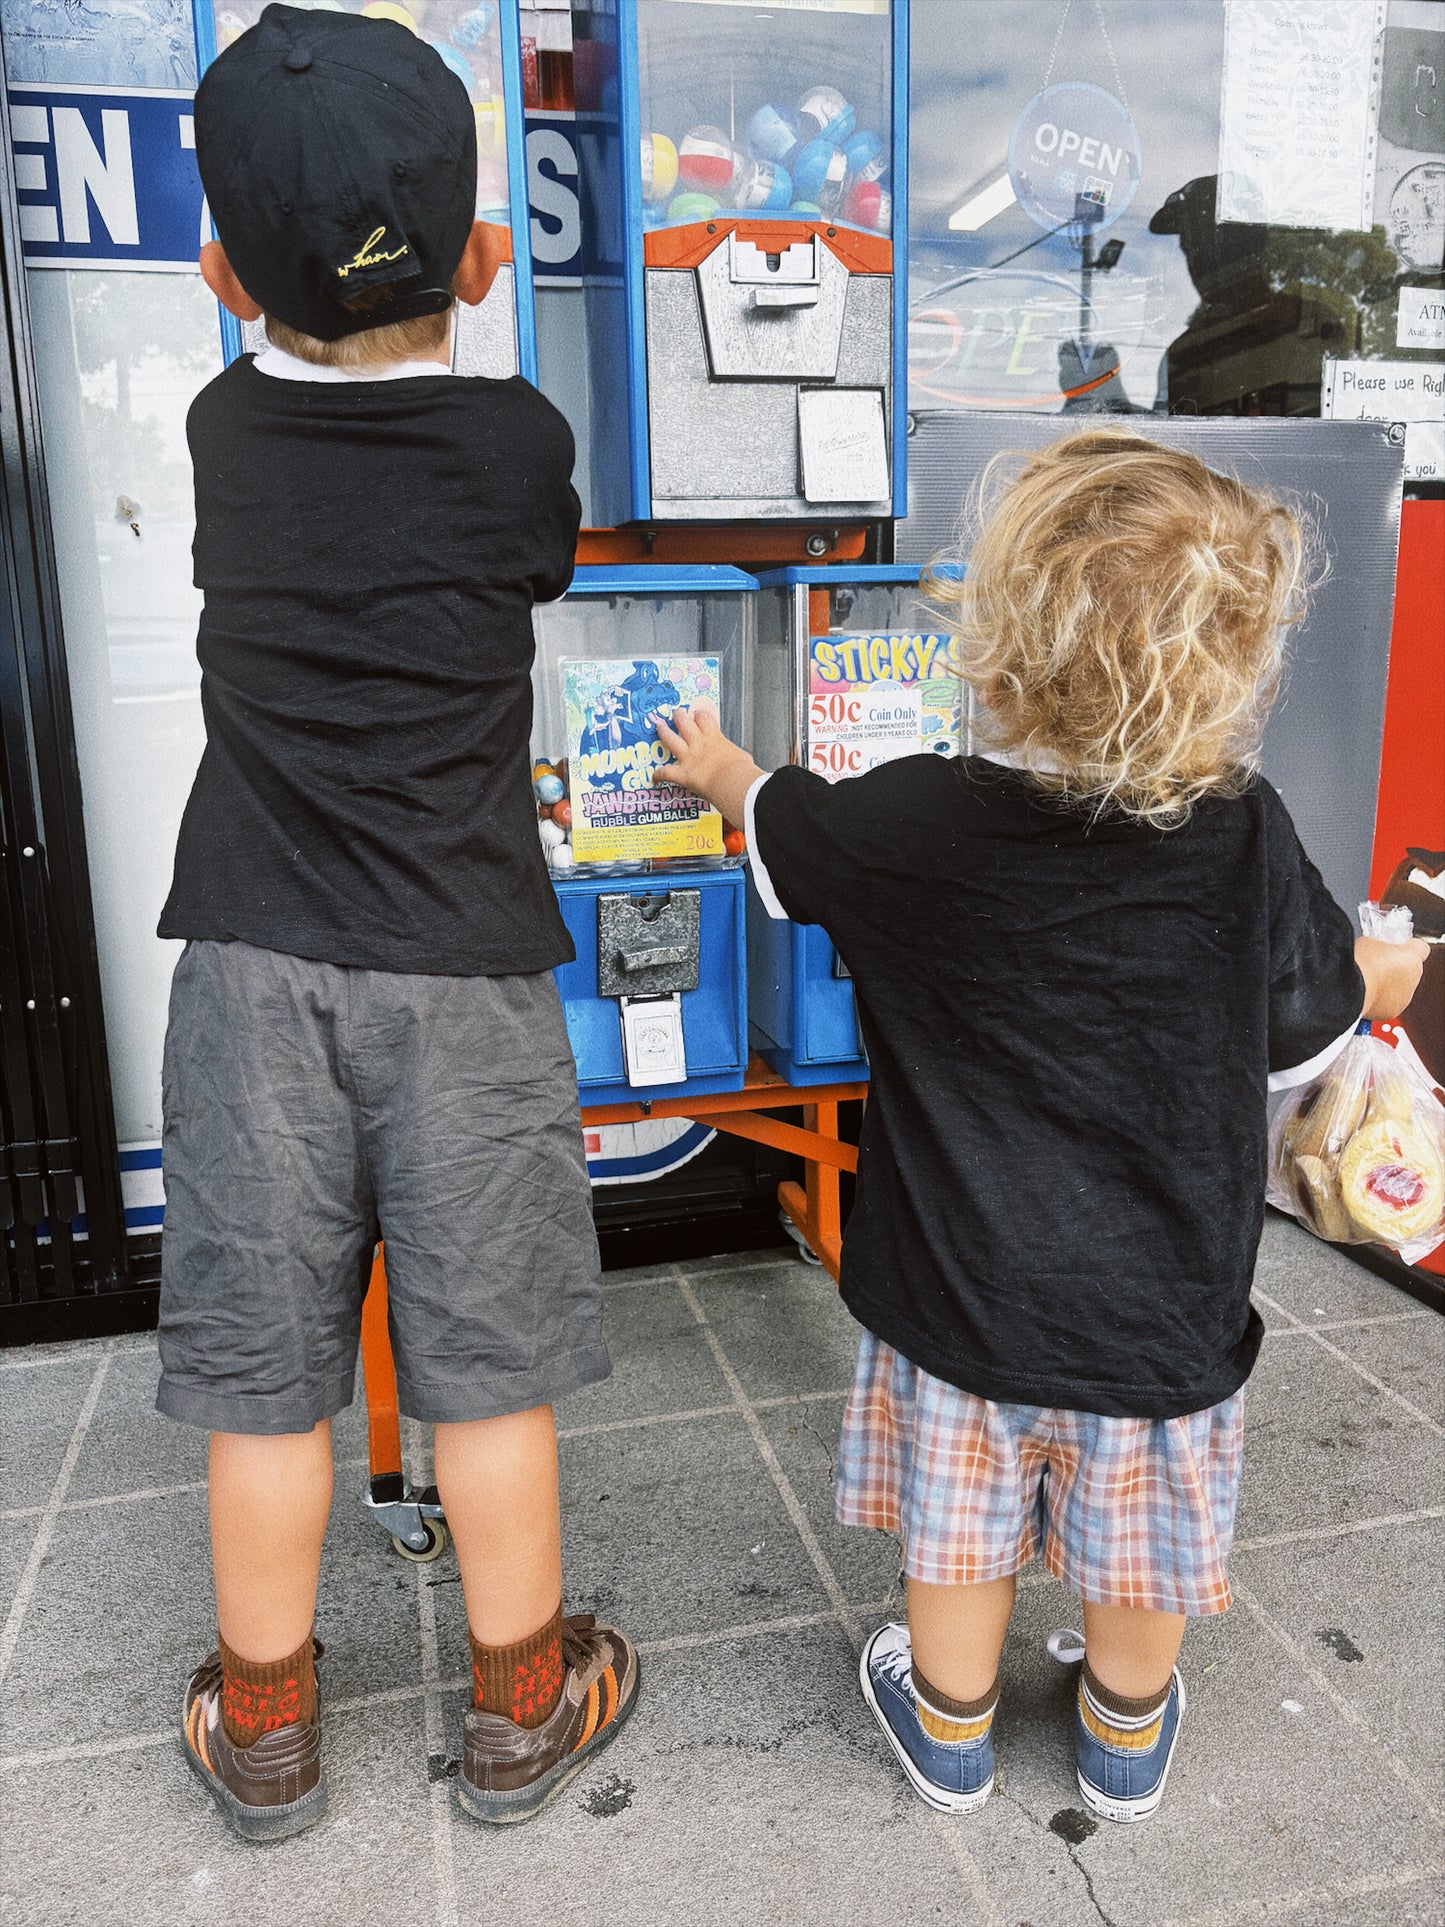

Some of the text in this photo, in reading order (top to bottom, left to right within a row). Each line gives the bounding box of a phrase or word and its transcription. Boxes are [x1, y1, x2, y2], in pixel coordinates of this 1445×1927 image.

[1035, 122, 1123, 176] OPEN
[1342, 370, 1387, 391] Please
[1394, 377, 1415, 391] use
[1415, 463, 1437, 479] you
[813, 634, 940, 684] STICKY
[810, 694, 918, 725] 50c Coin Only
[836, 731, 864, 740] CHILDREN
[864, 730, 883, 739] UNDER
[888, 729, 906, 738] YEARS
[906, 728, 918, 736] OLD
[863, 721, 906, 732] RECOMMENDED
[905, 720, 918, 729] FOR
[579, 738, 676, 781] MUMBO
[810, 743, 862, 773] 50c
[621, 765, 655, 791] GU
[581, 783, 711, 818] JAWBREAKER
[592, 807, 698, 829] BUBBLE GUM BALLS
[686, 834, 715, 851] 20c
